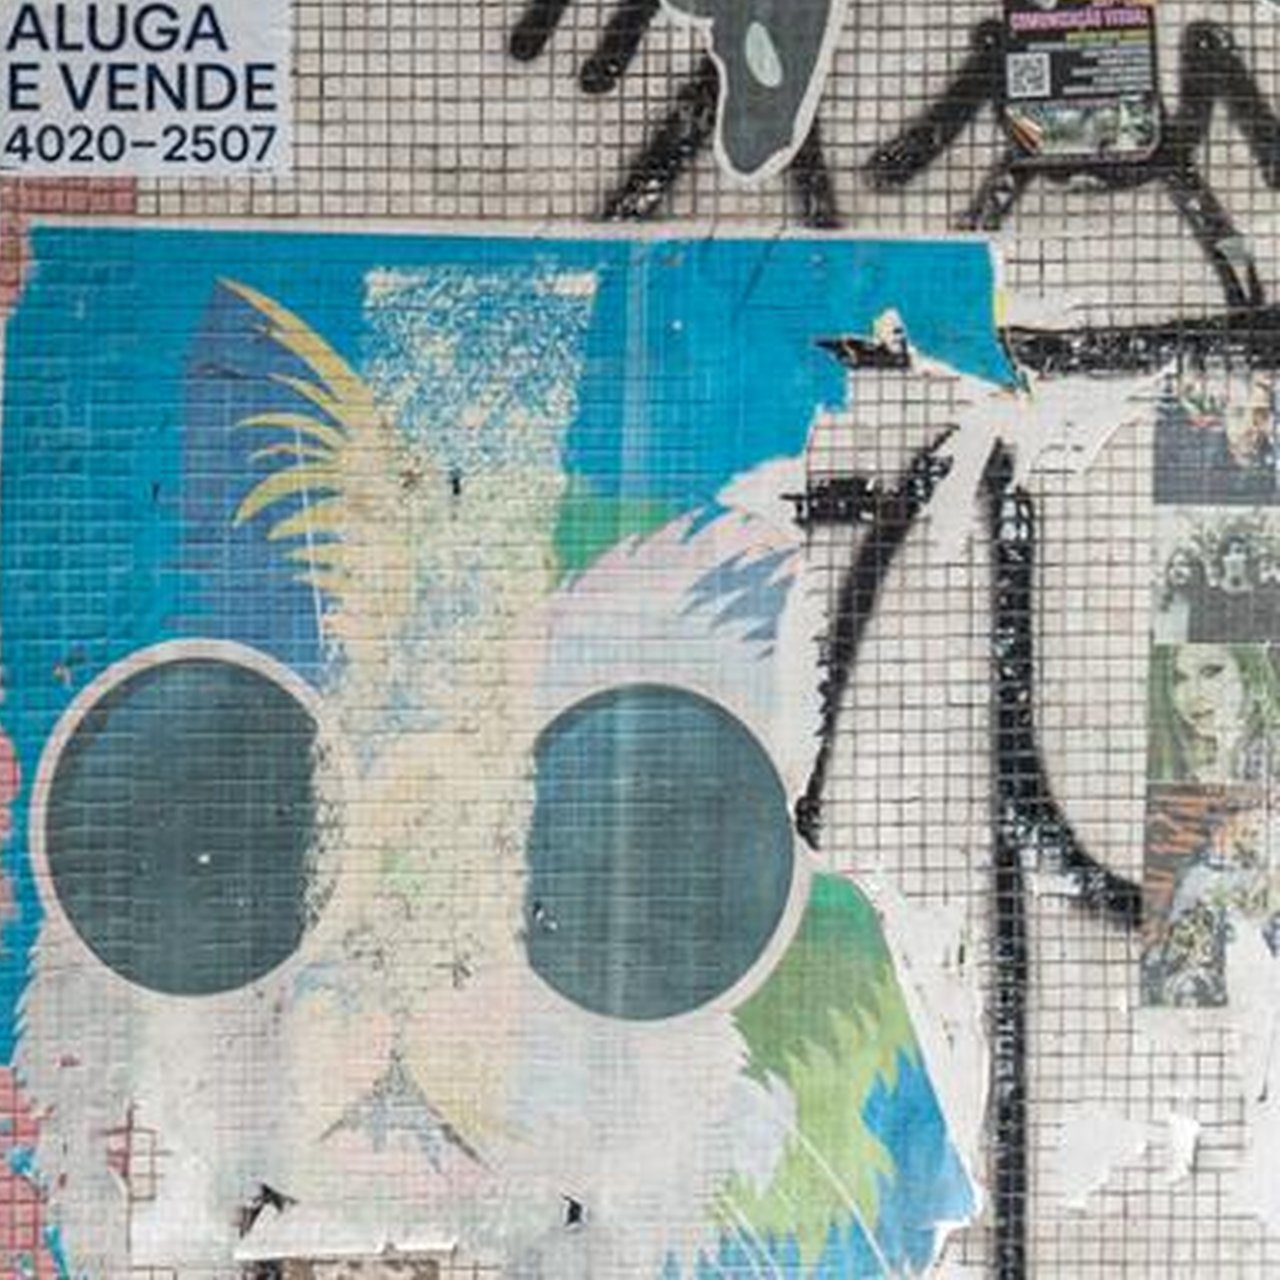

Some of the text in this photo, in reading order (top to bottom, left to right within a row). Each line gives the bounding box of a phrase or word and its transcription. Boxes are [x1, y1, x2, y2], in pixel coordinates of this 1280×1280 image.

[5, 3, 229, 52] ALUGA
[8, 63, 277, 111] E VENDE
[3, 125, 277, 163] 4020-2507
